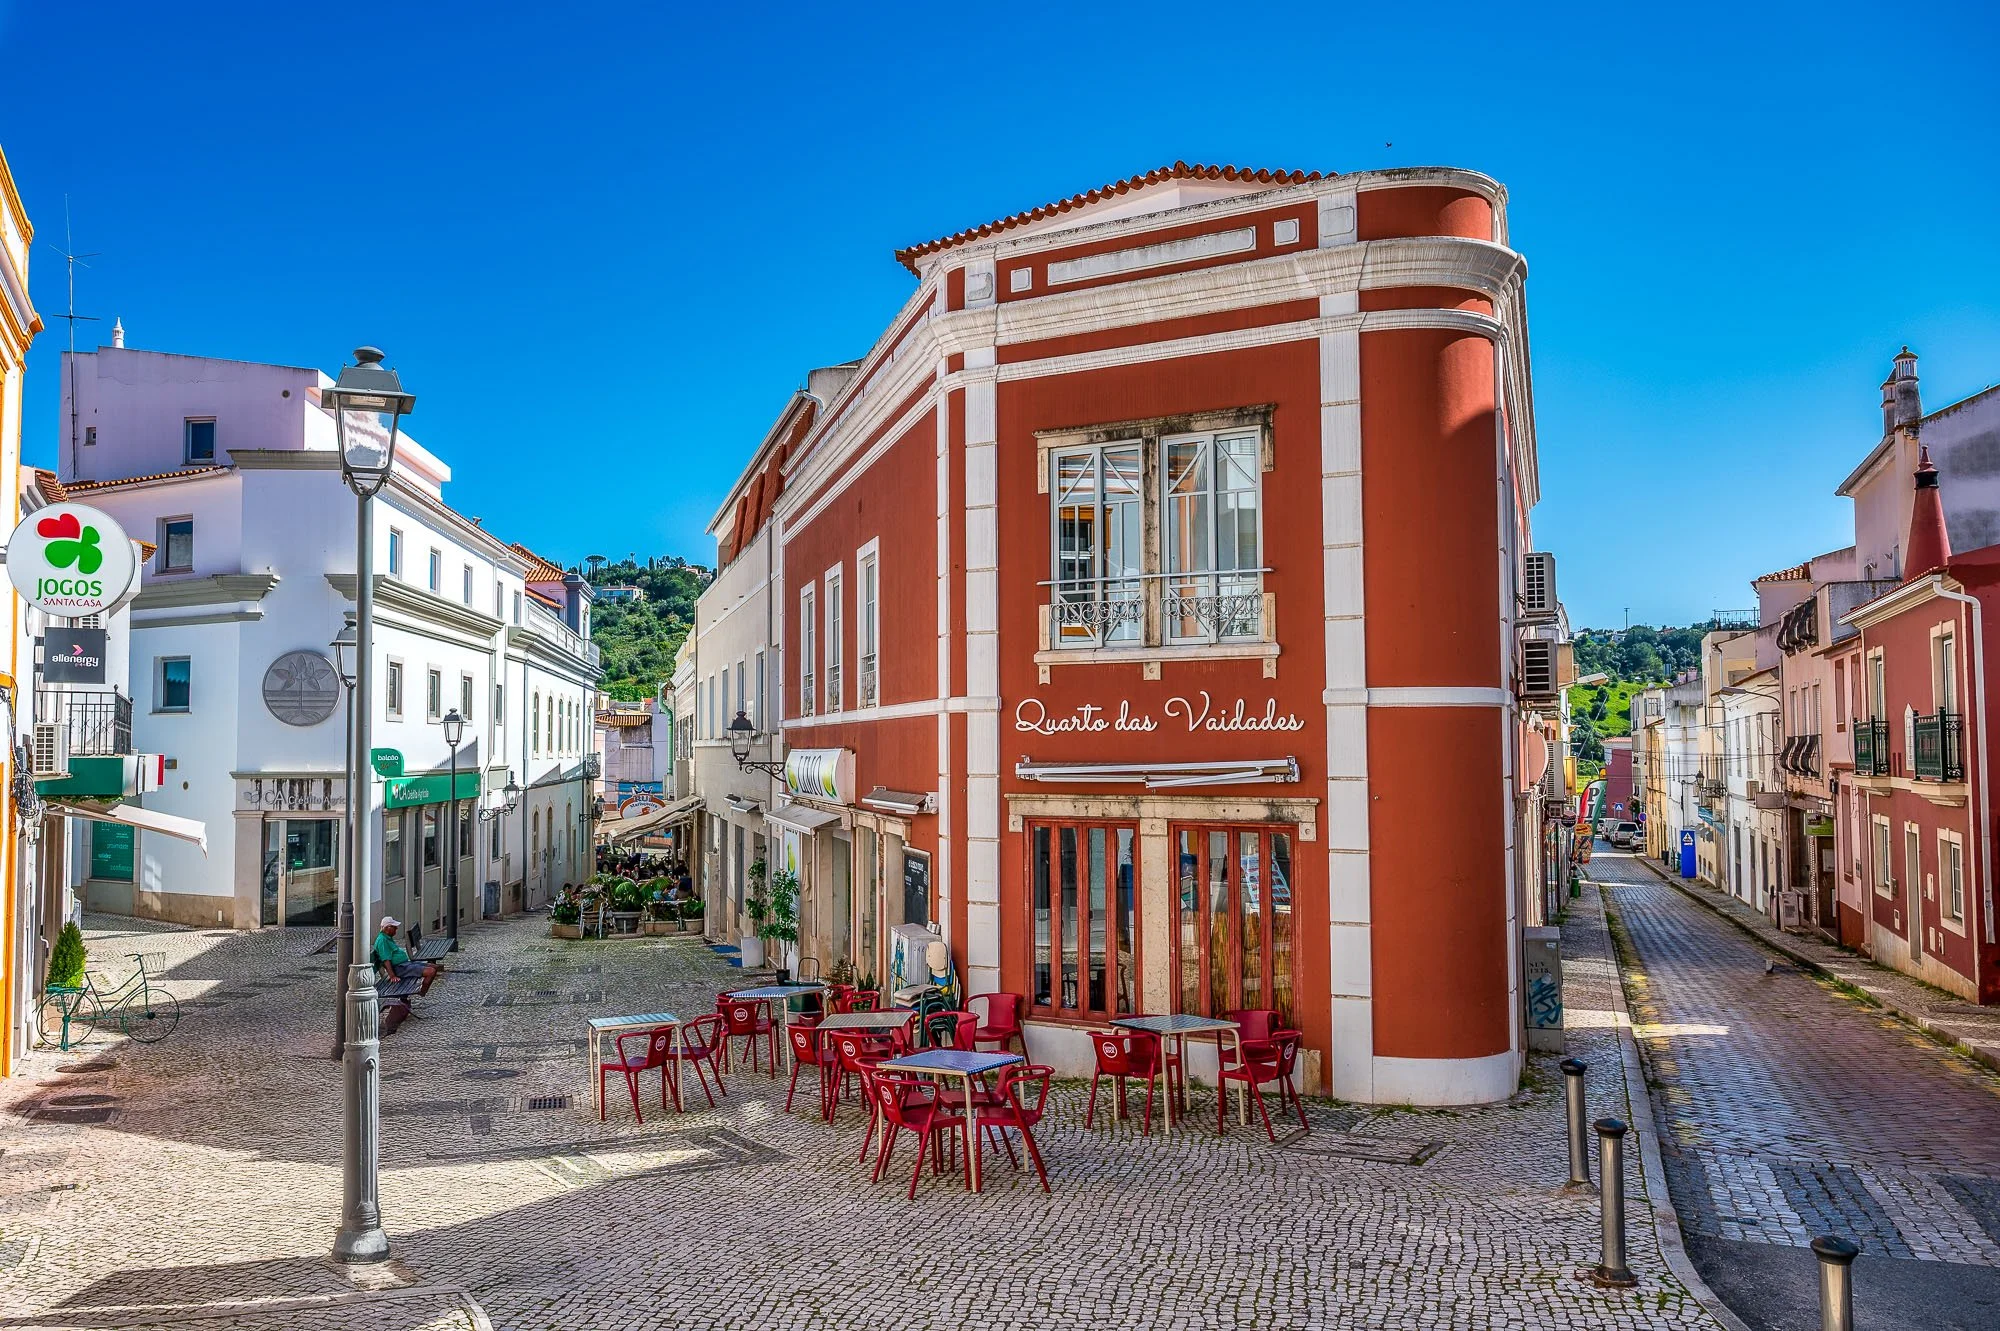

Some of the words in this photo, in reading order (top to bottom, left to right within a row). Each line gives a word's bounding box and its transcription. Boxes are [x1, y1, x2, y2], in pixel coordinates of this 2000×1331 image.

[36, 578, 102, 600] JOGOS
[1015, 698, 1110, 735] Quarto
[1114, 700, 1158, 732] das
[1164, 690, 1305, 732] Vaidades
